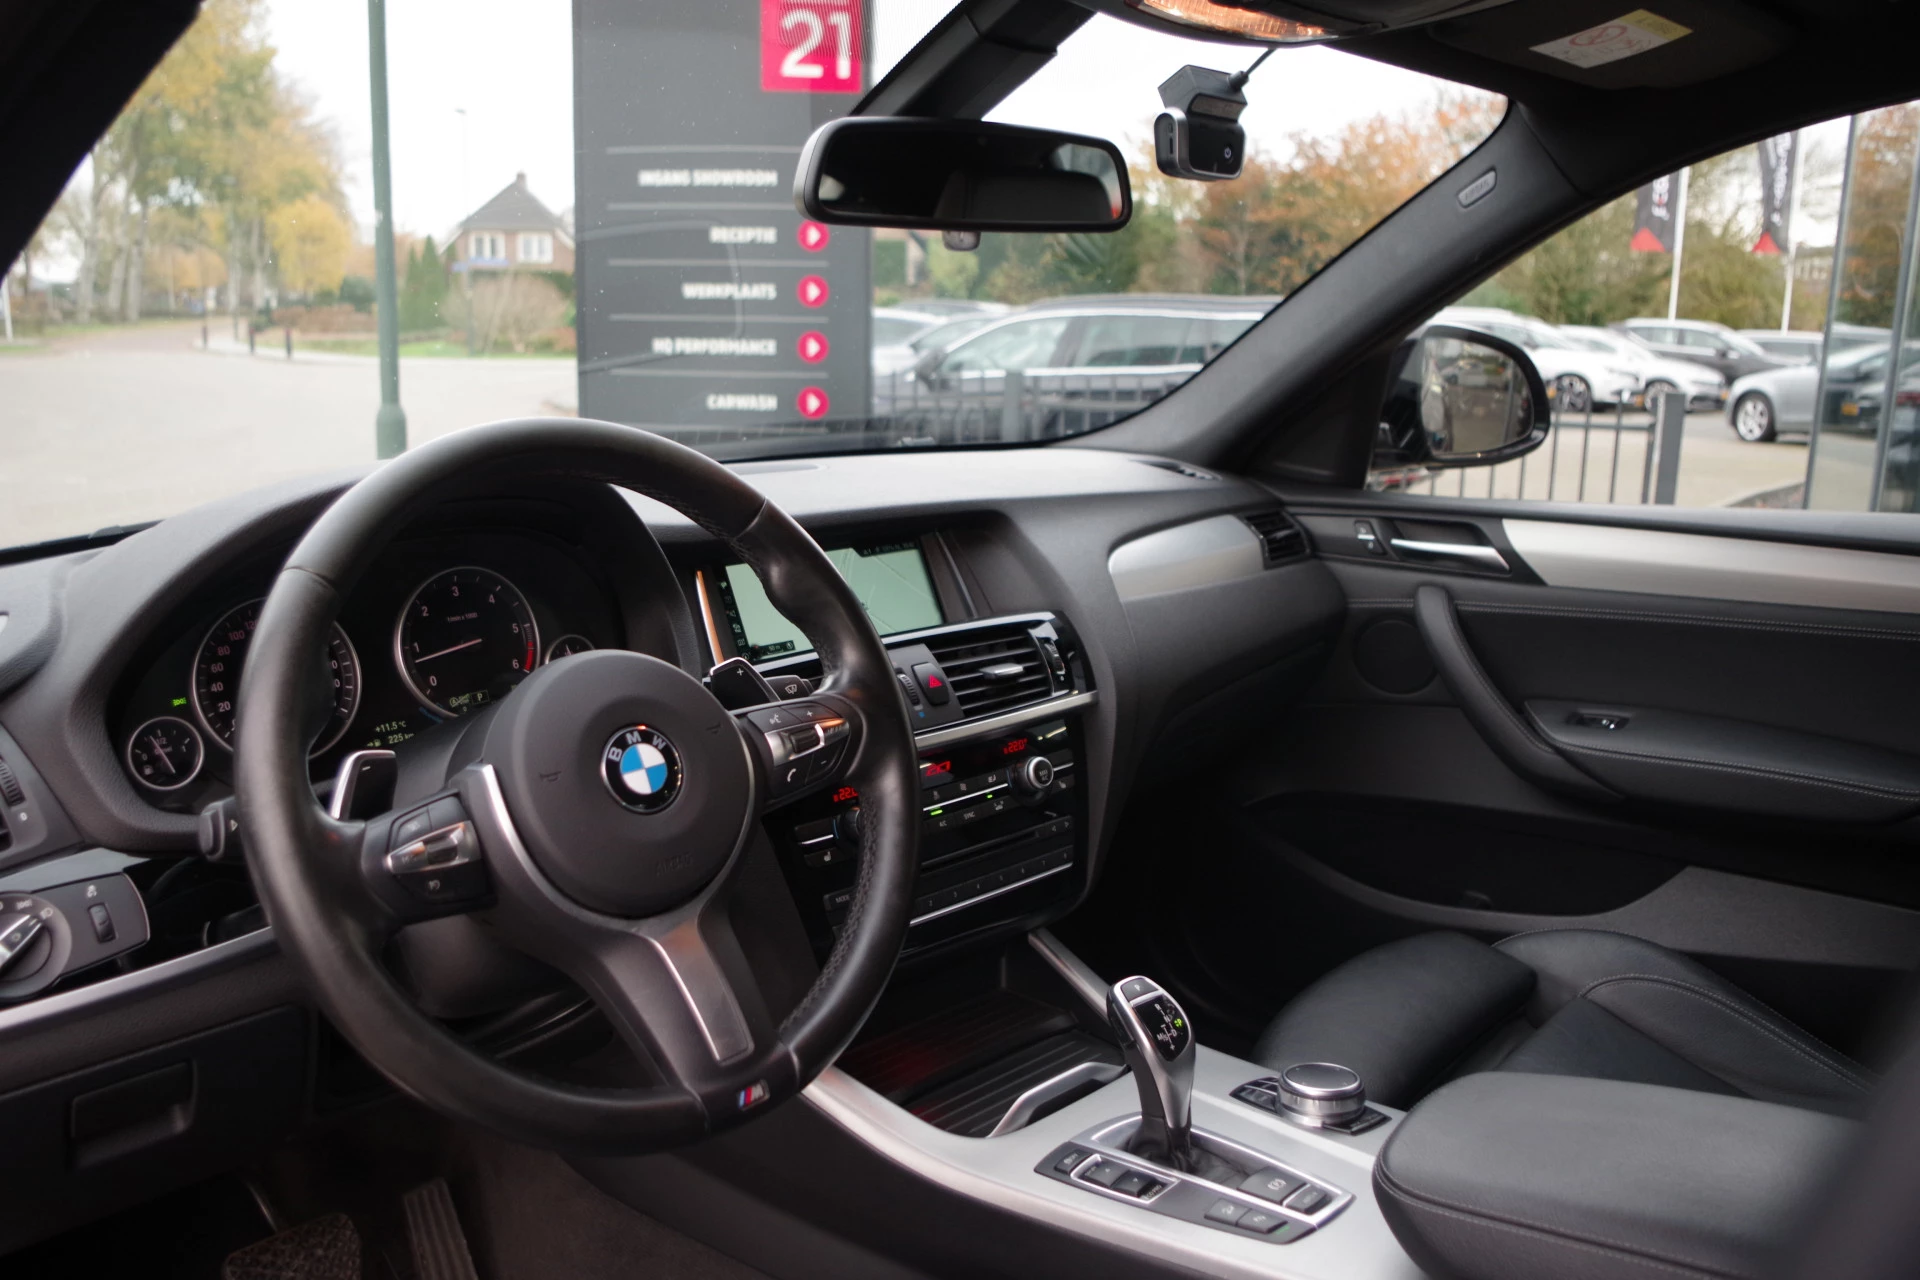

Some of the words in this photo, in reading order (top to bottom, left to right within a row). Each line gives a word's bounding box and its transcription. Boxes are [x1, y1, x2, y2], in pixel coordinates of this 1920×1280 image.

[782, 9, 851, 80] 21
[693, 169, 778, 187] SHOWROOM
[710, 227, 778, 244] RECEPTIE
[682, 282, 777, 300] WERKPLAATS
[675, 337, 777, 356] PERFORMANCE
[706, 394, 778, 411] CARWASH
[452, 586, 459, 596] 3
[489, 594, 495, 604] 4
[422, 606, 429, 616] 2
[512, 623, 519, 633] 5
[228, 631, 245, 641] 100
[217, 646, 230, 656] 80
[413, 642, 420, 652] 1
[211, 663, 224, 673] 60
[512, 659, 519, 669] 6
[430, 675, 437, 686] 0
[211, 682, 224, 692] 40
[218, 702, 231, 712] 20
[388, 733, 404, 744] 225
[608, 730, 667, 762] BMW
